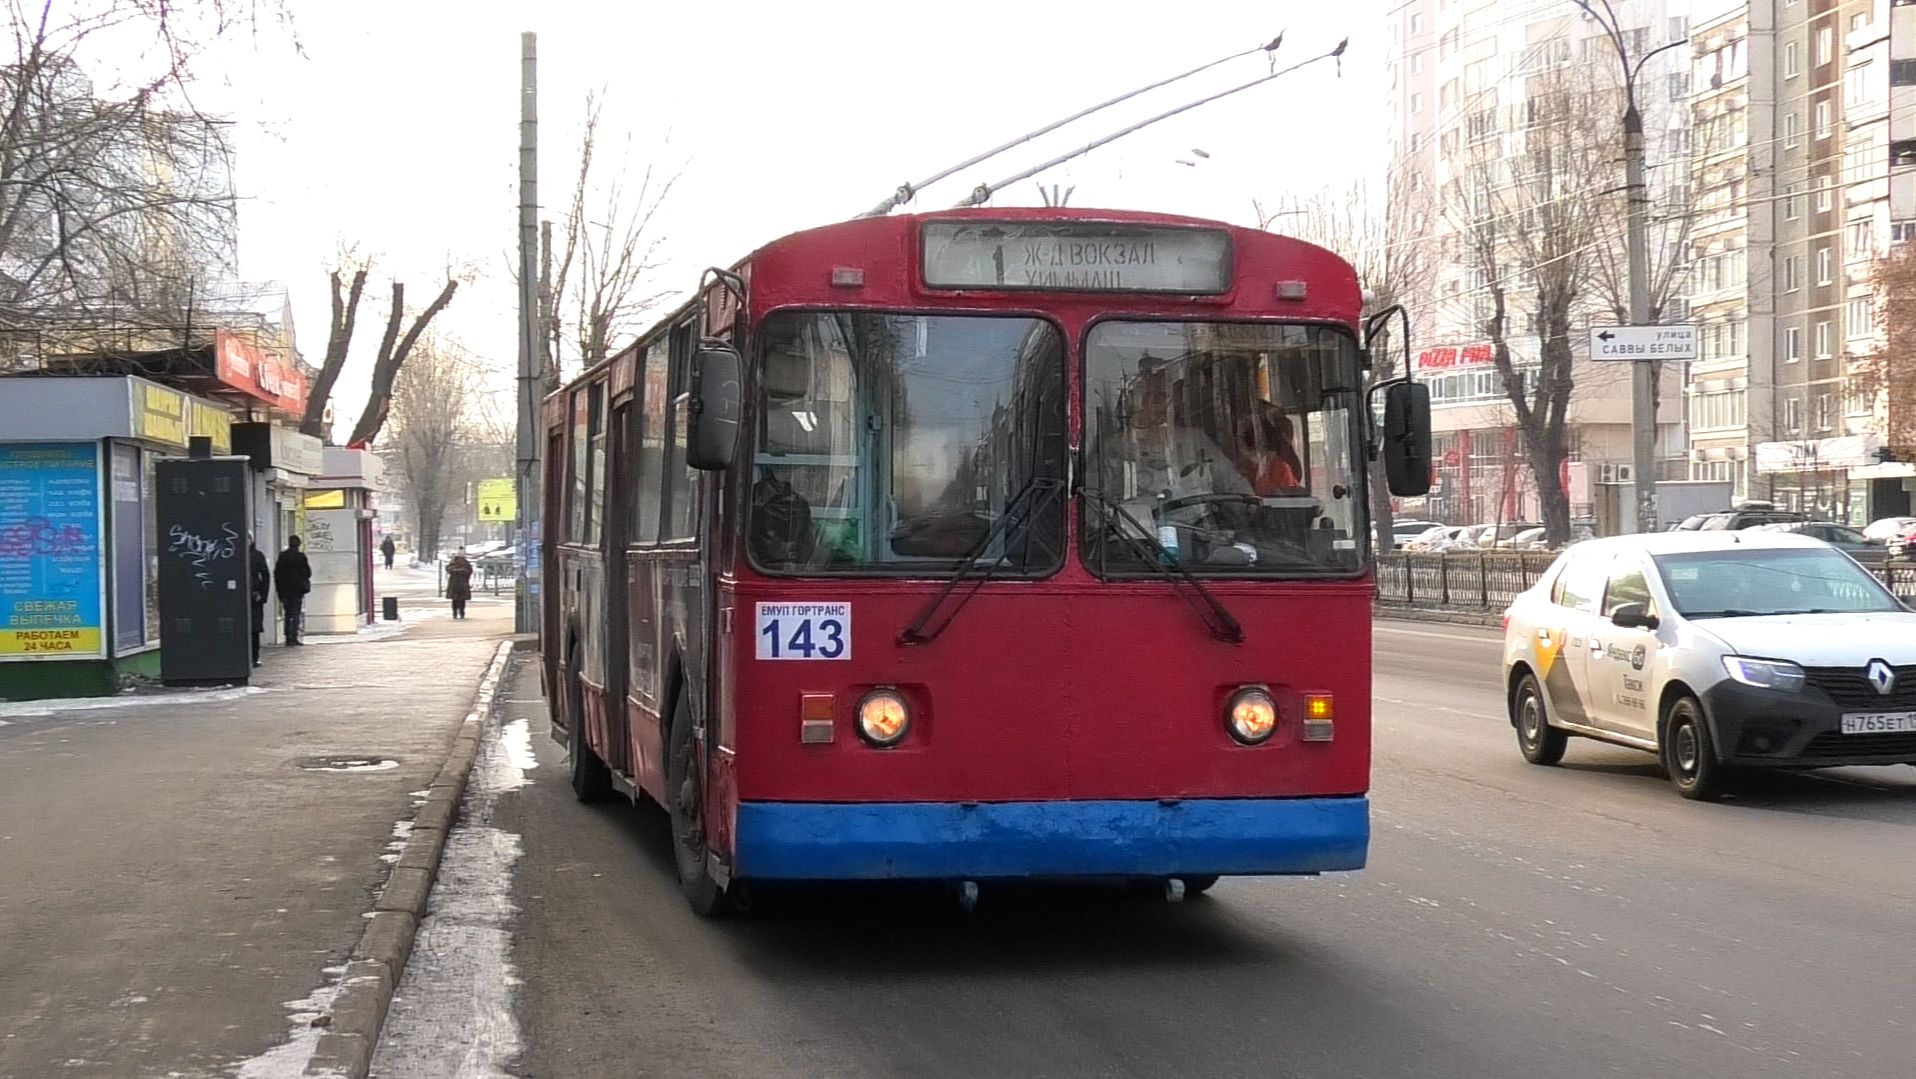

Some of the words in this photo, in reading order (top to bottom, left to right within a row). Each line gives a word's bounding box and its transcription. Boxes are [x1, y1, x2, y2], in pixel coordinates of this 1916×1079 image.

[1070, 242, 1155, 265] ВОКЗАЛ
[992, 244, 1004, 284] 1
[1656, 331, 1691, 340] улица
[1602, 344, 1645, 354] САВВЫ
[1650, 343, 1691, 353] БЕЛЫХ
[14, 600, 77, 612] СВЕЖАЯ
[761, 605, 790, 616] ЕМУП
[792, 605, 845, 616] ГОРТРАНС
[9, 614, 81, 626] ВЫПЕЧКА
[16, 630, 79, 641] РАБОТАЕМ
[763, 619, 844, 658] 143
[24, 642, 37, 651] 24
[40, 641, 72, 651] ЧАСА
